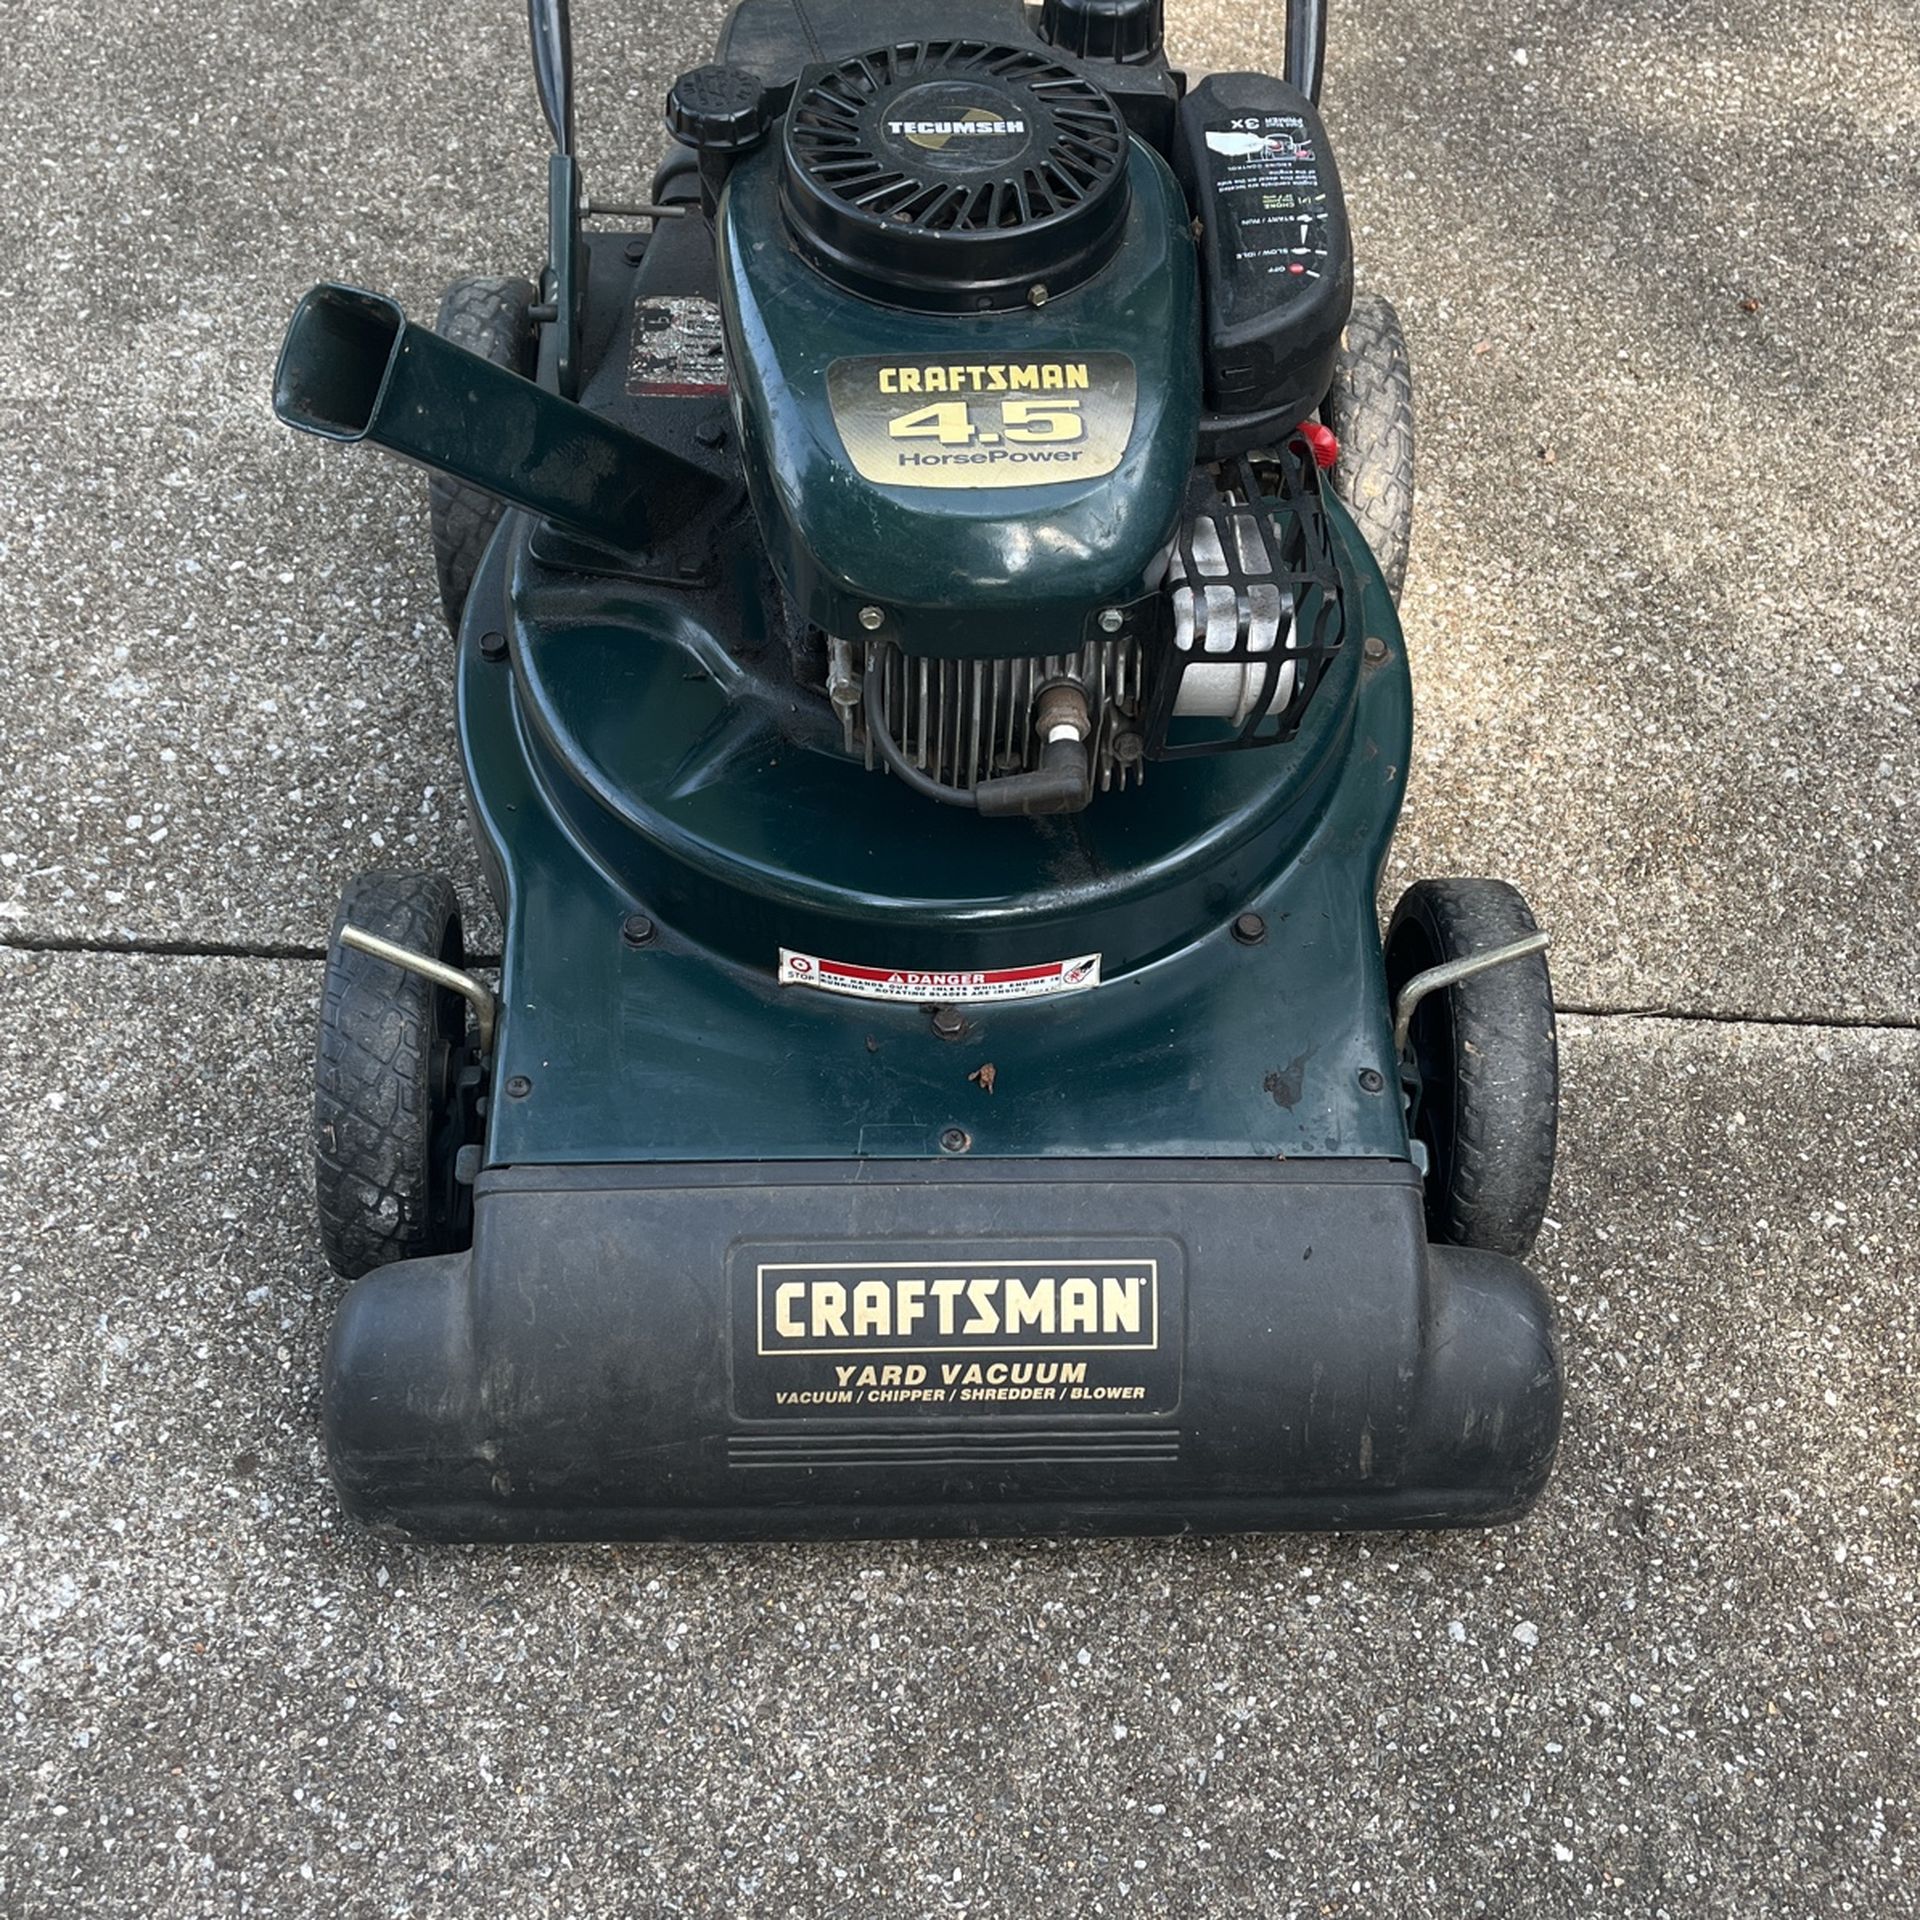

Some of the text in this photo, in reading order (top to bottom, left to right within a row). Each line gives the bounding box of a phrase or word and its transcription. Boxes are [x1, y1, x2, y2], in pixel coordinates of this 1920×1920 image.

[888, 120, 1024, 134] TECUMSEH
[1227, 163, 1262, 171] CONTROL
[1267, 215, 1295, 223] START
[1236, 251, 1256, 260] IDLE
[1262, 248, 1289, 256] SLOW
[1267, 265, 1286, 273] OFF
[878, 364, 1089, 394] CRAFTSMAN
[888, 400, 1087, 445] 4.5
[898, 449, 1083, 467] HorsePower
[788, 971, 814, 981] STOP
[907, 973, 985, 985] DANGER
[850, 978, 883, 988] HANDS
[973, 983, 1003, 991] WHILE
[1009, 979, 1045, 988] ENGINE
[875, 987, 926, 996] ROTATING
[775, 1277, 1140, 1338] CRAFTSMAN
[835, 1363, 1087, 1387] YARD VACUUM
[776, 1391, 853, 1405] VACUUM
[867, 1389, 945, 1403] CHIPPER
[959, 1387, 1055, 1402] SHREDDER
[1070, 1386, 1146, 1400] BLOWER
